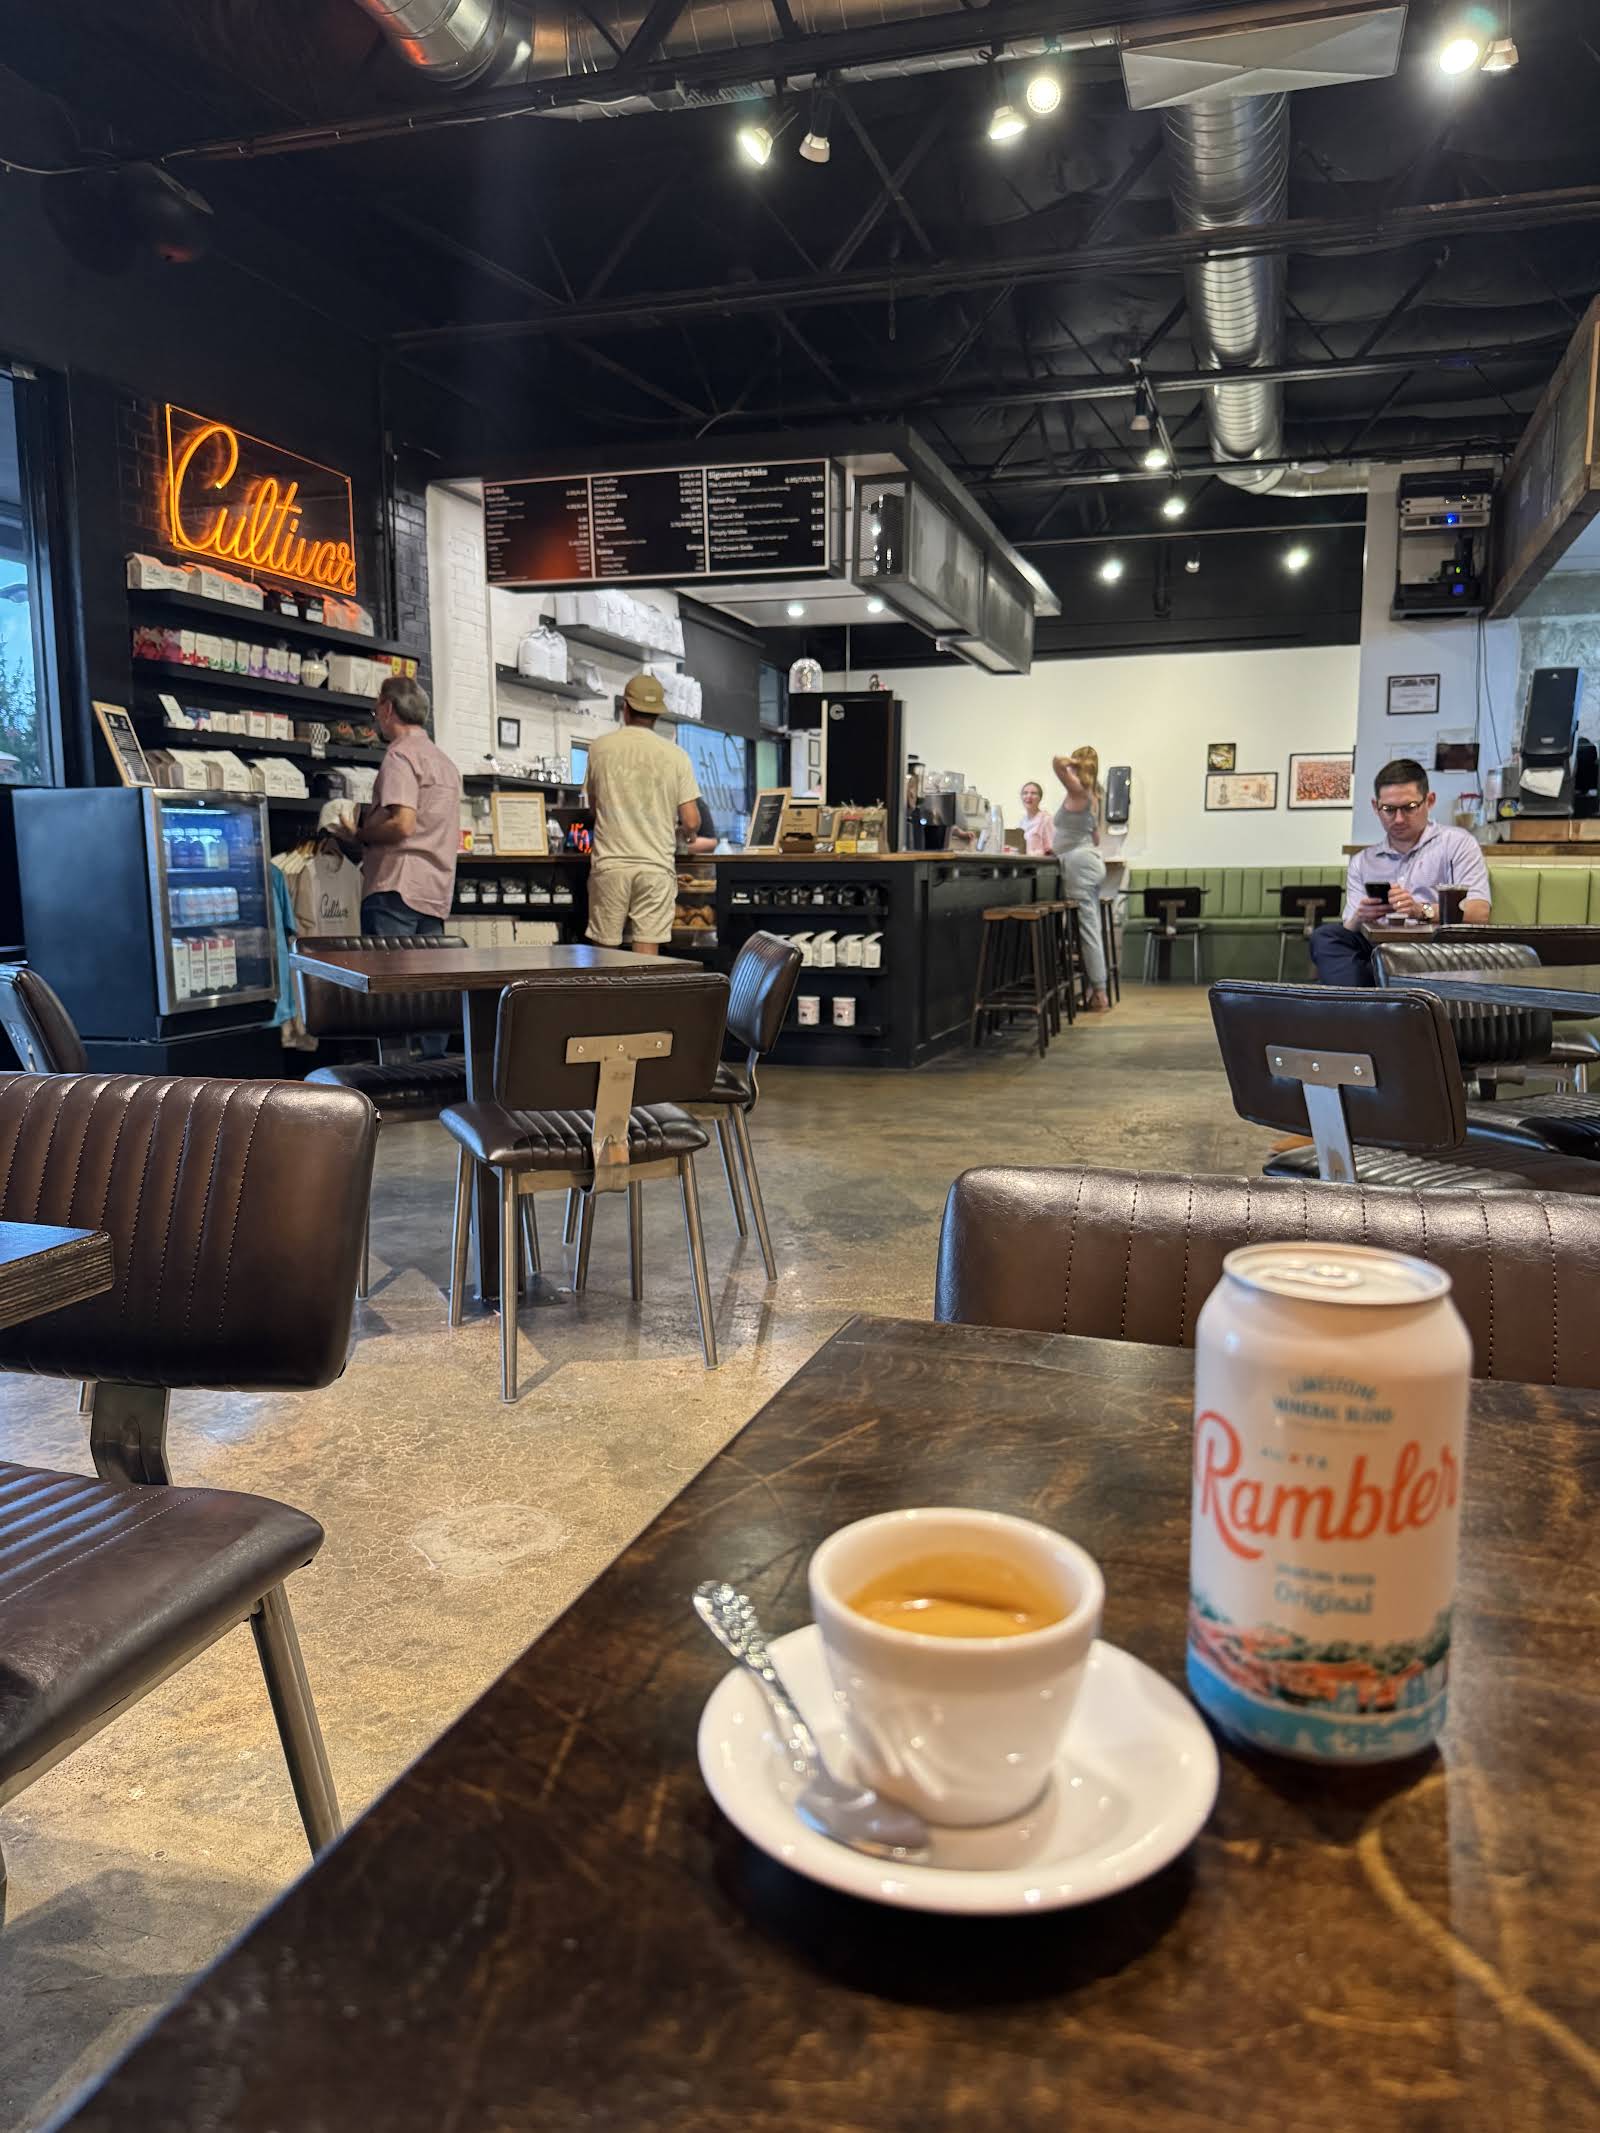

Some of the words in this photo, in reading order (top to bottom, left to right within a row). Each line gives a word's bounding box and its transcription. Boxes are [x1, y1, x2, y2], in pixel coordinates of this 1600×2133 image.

[708, 471, 743, 481] Signature
[743, 468, 768, 477] Drinks
[173, 423, 355, 590] Cultivar
[1274, 1397, 1337, 1421] MINERAL
[1195, 1410, 1459, 1561] Rambler
[1274, 1581, 1374, 1616] Original
